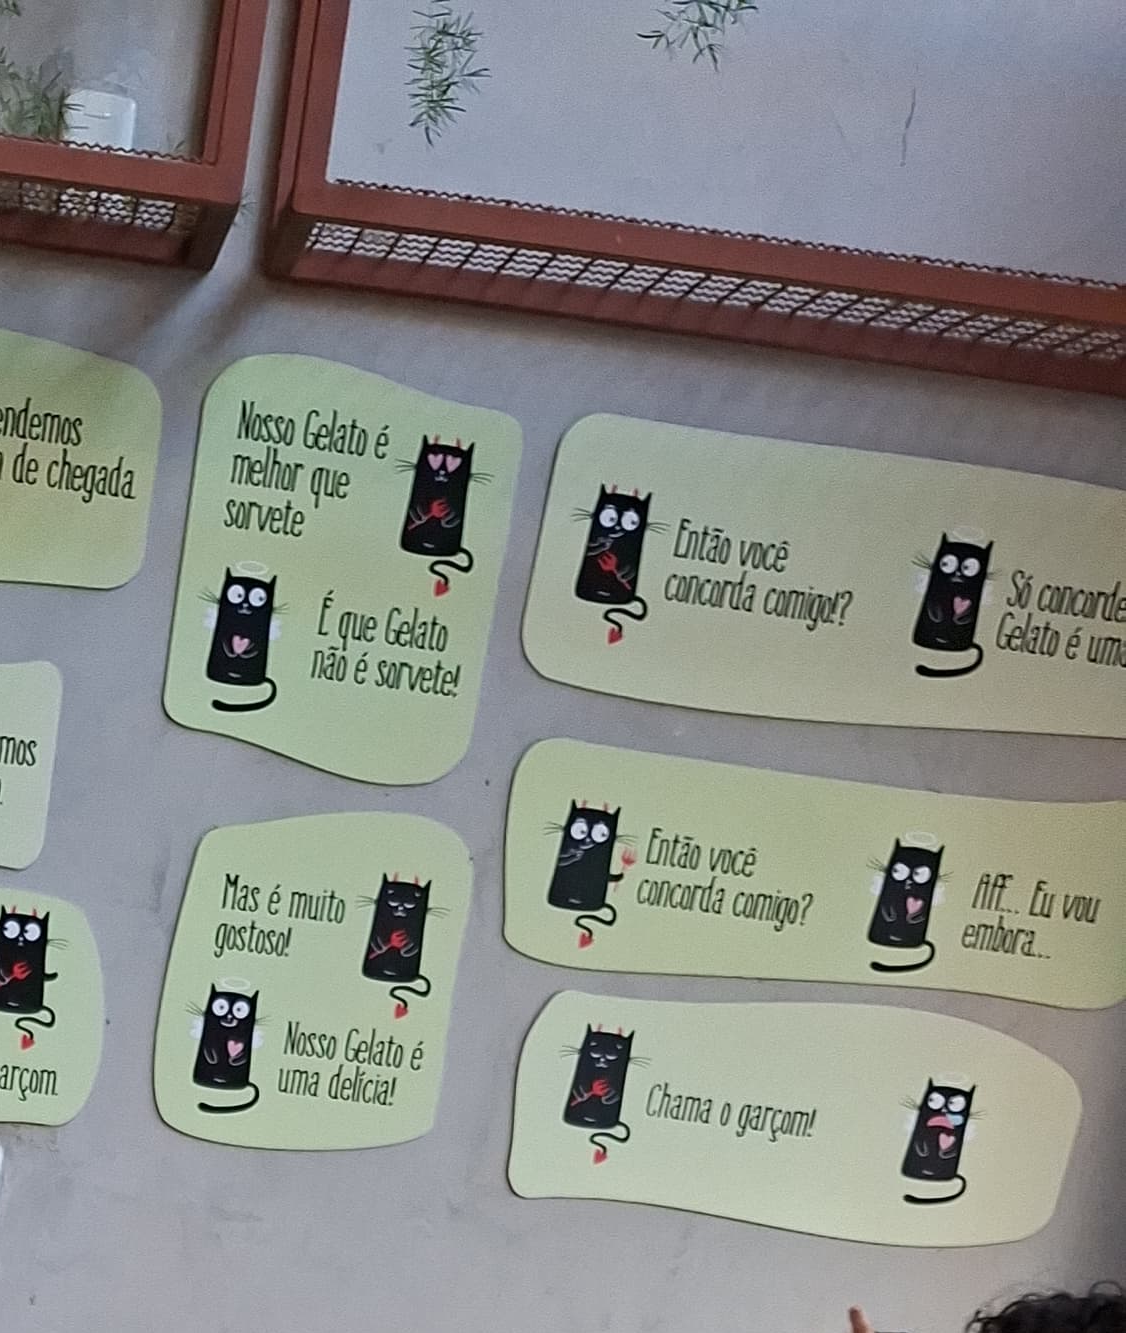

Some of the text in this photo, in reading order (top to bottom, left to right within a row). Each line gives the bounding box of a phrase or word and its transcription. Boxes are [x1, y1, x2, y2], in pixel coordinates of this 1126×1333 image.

[237, 400, 391, 460] Nosso Gelato é
[12, 443, 40, 486] de
[46, 448, 136, 504] chegada
[230, 447, 351, 509] melhor que
[223, 499, 306, 538] sorvete
[673, 518, 790, 573] Então você
[664, 570, 757, 615] concorda
[1005, 569, 1034, 608] Só
[317, 589, 449, 653] É que Gelato
[995, 611, 1061, 658] Gelato
[1065, 626, 1083, 660] é
[311, 646, 462, 698] não é sorvete!
[645, 827, 758, 877] Então você
[221, 873, 347, 925] Mas é muito
[636, 875, 814, 932] concorda comigo?
[1029, 878, 1058, 919] Eu
[1061, 892, 1102, 925] vou
[214, 920, 293, 959] gostoso!
[283, 1021, 425, 1071] Nosso Gelato é
[278, 1064, 397, 1107] uma delícia!
[644, 1082, 817, 1143] Chama o garçom!
